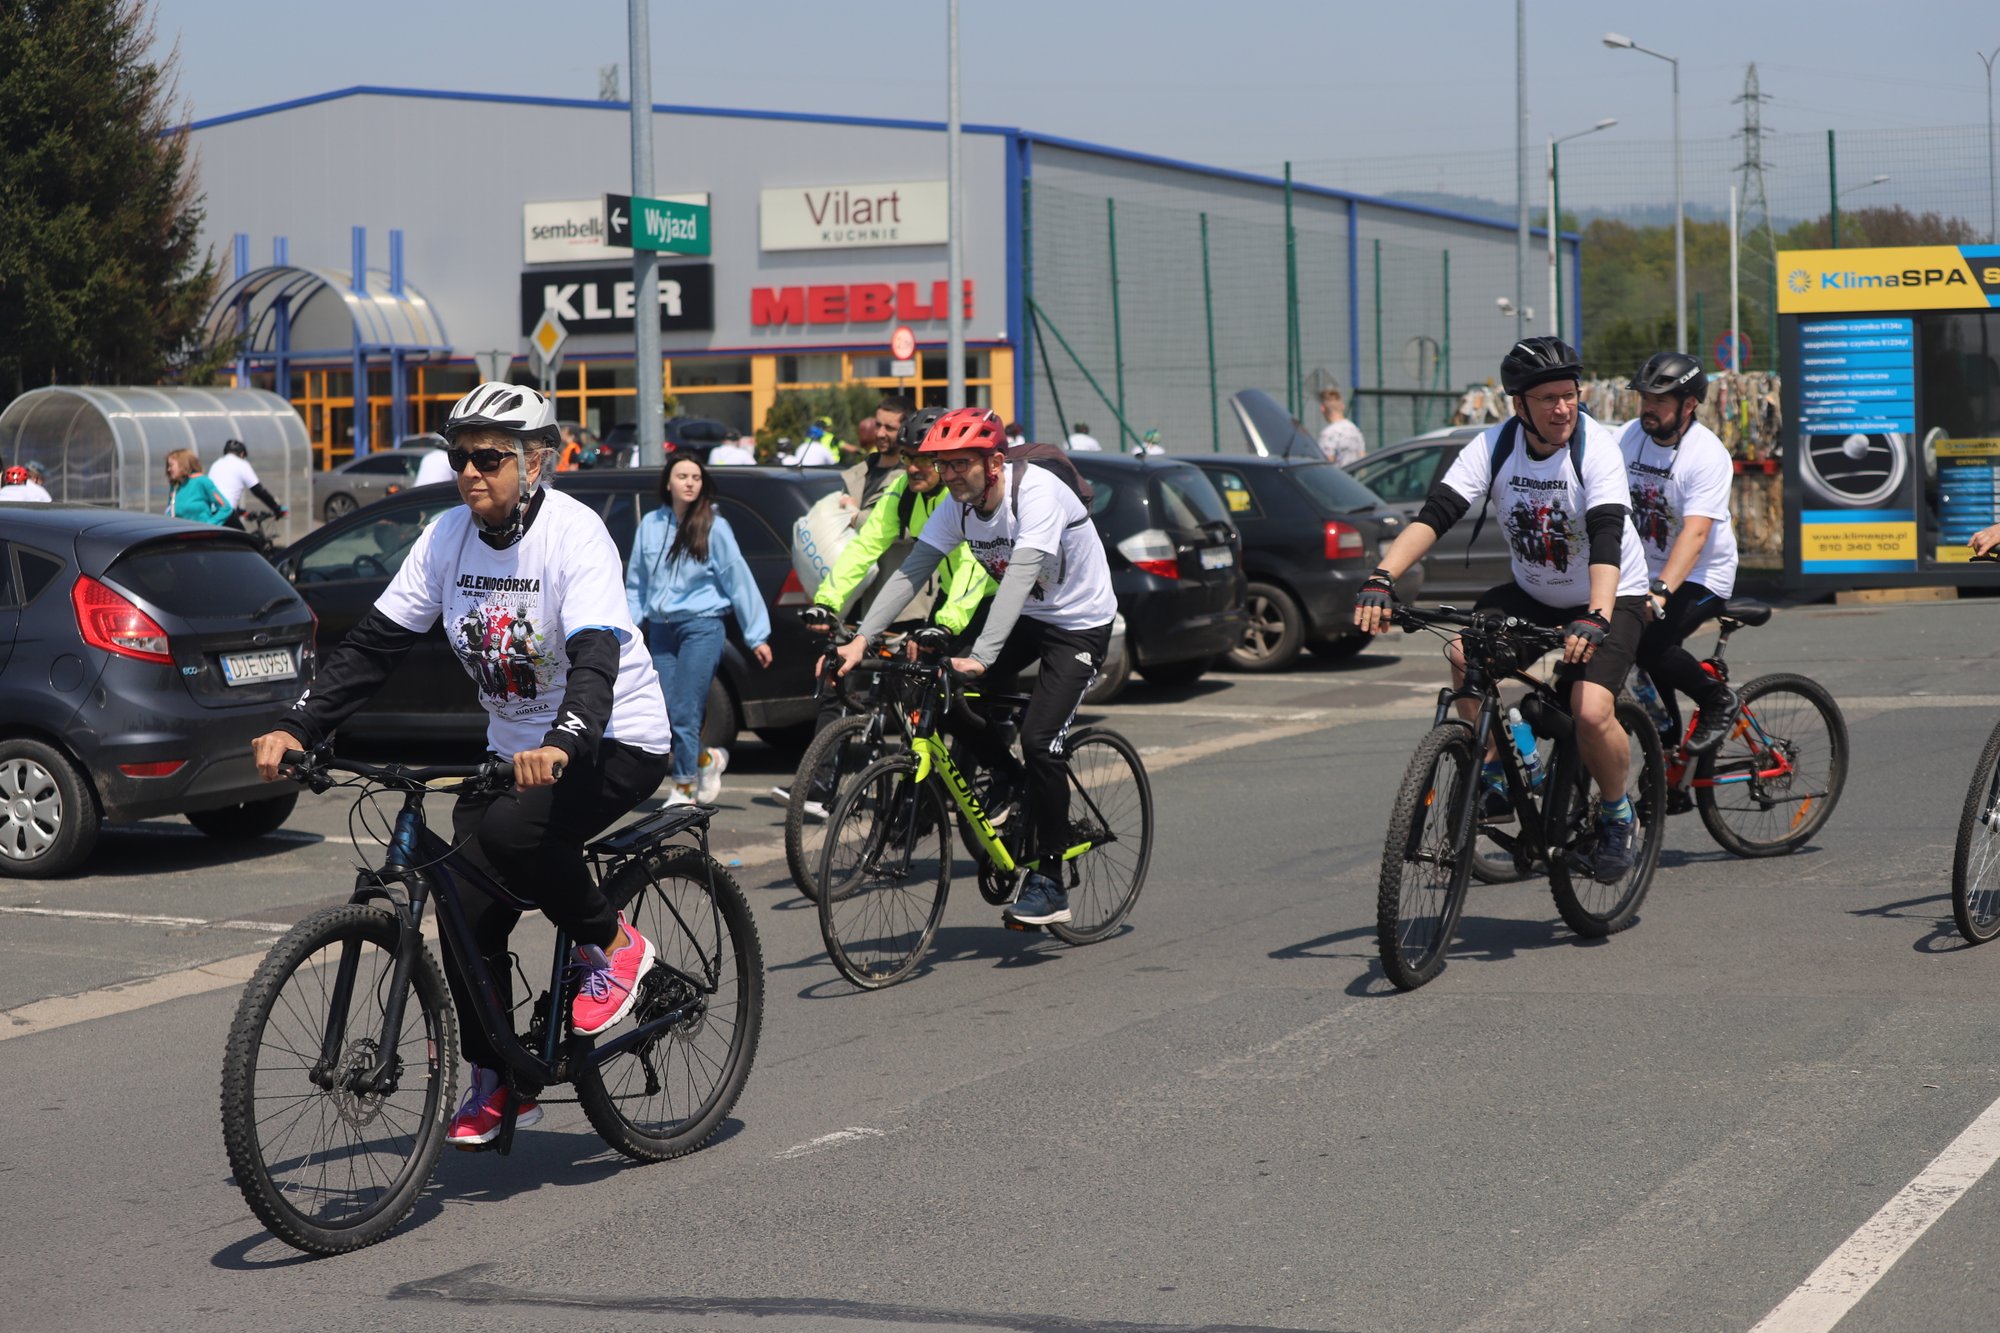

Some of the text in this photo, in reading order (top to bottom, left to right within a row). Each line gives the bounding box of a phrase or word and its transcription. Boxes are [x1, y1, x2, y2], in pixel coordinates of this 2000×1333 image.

[804, 190, 902, 226] Vilart
[644, 207, 697, 244] Wyjazd
[821, 228, 899, 242] KUCHNIE
[1821, 268, 1967, 289] KlimaSPA
[543, 279, 683, 321] KLER
[751, 279, 974, 326] MEBLE
[1812, 532, 1907, 541] www.klimaspa.pl
[1877, 542, 1900, 551] 100
[456, 574, 540, 593] JELENIOGÓRSKA
[229, 655, 259, 678] DJE
